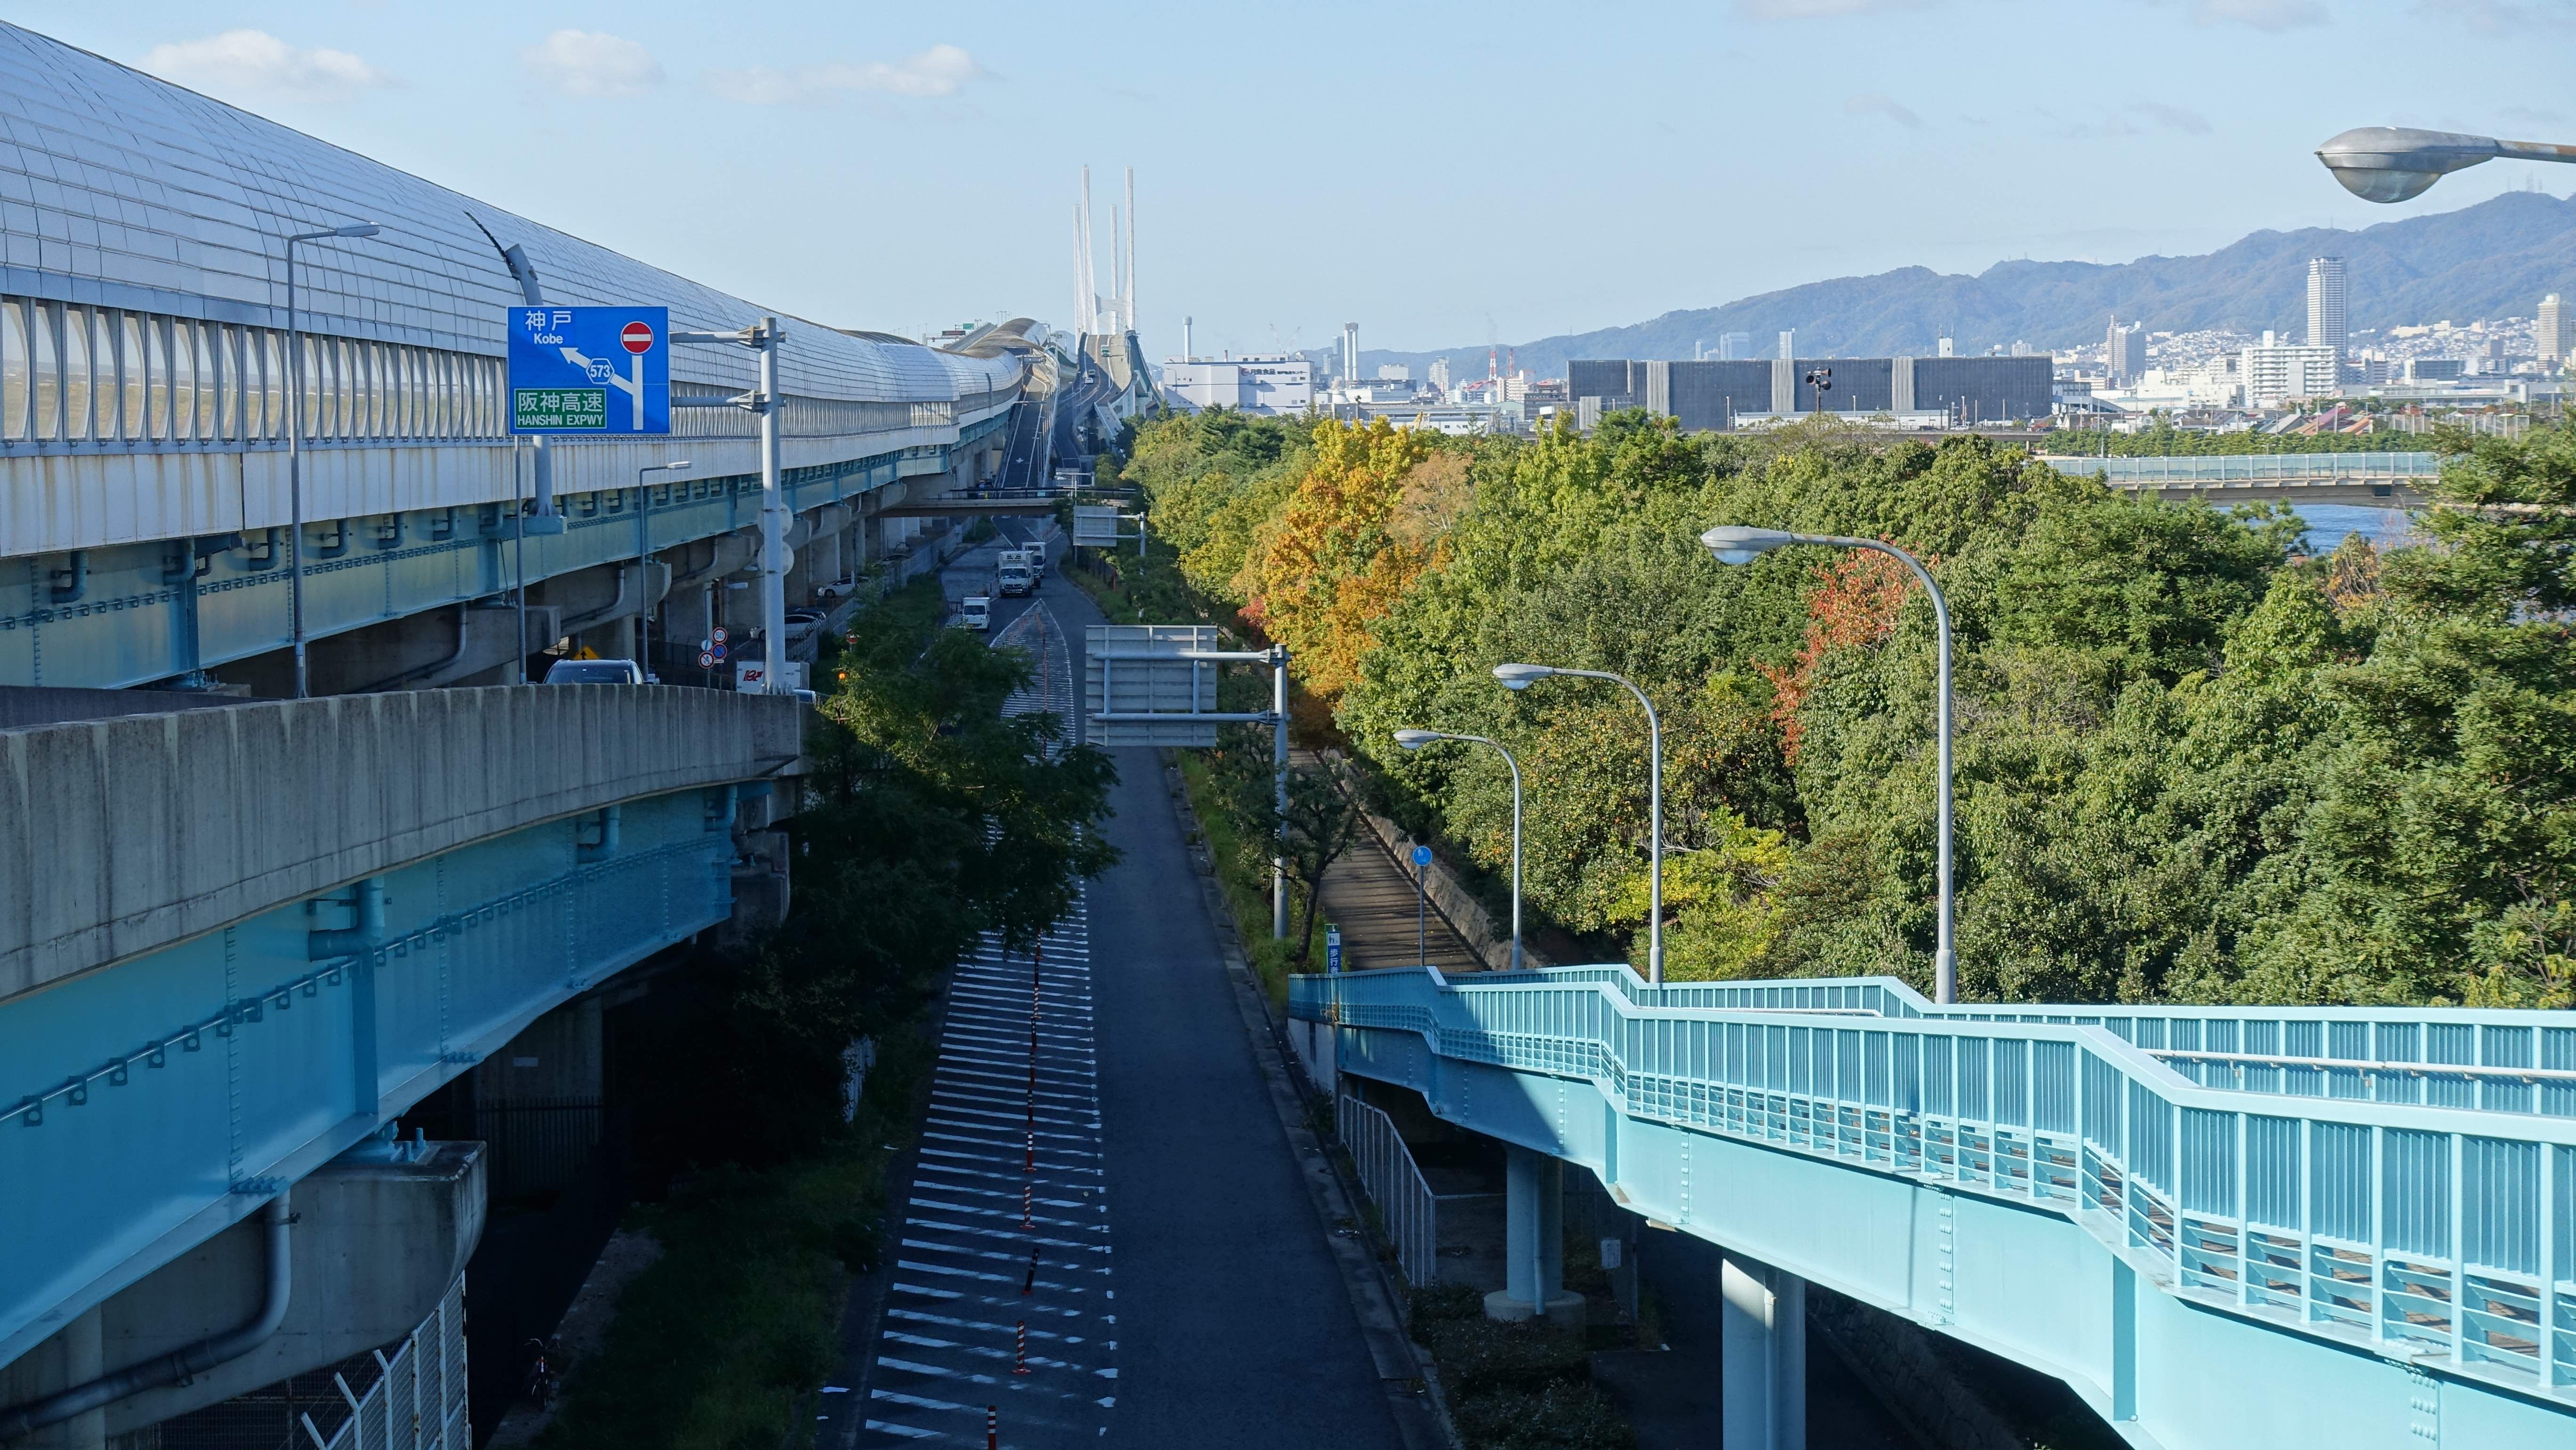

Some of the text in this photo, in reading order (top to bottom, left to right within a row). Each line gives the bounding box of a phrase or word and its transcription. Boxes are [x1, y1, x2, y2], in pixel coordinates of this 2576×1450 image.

[525, 310, 572, 331] 神戸
[534, 333, 564, 344] Kobe
[590, 365, 610, 378] 573
[518, 392, 603, 412] 阪神高速
[518, 415, 603, 426] HANSHIN EXPWY
